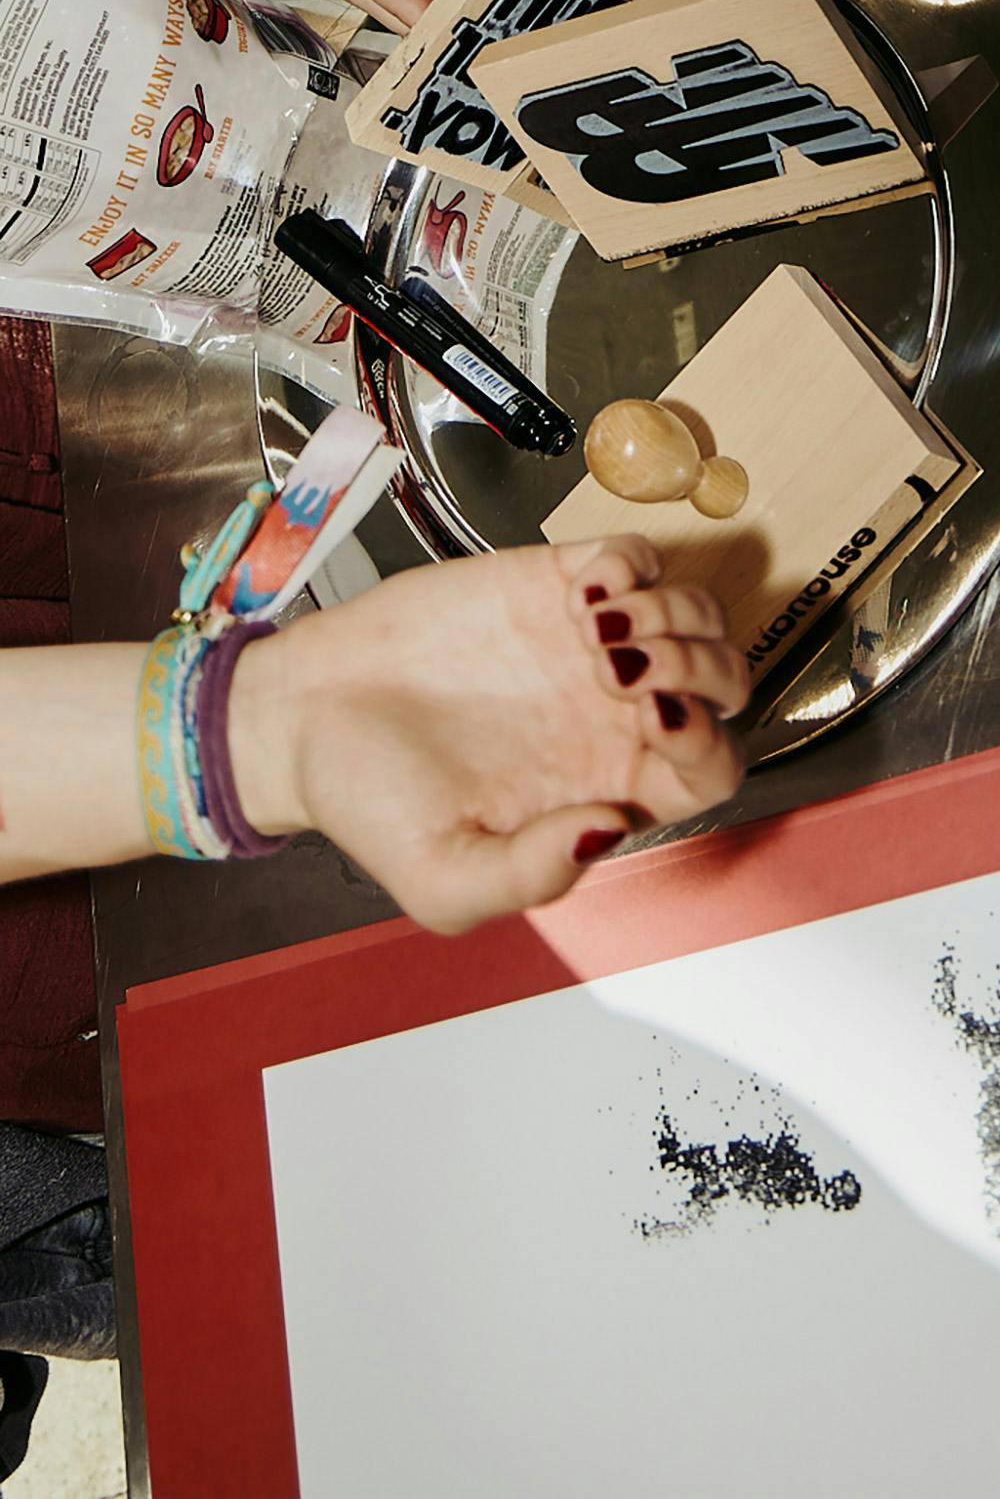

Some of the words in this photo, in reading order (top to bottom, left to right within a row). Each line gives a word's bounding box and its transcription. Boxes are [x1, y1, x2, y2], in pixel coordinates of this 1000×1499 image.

[142, 54, 177, 111] MANY
[131, 112, 156, 140] SO
[125, 144, 149, 169] IN
[116, 169, 139, 192] IT
[79, 195, 127, 247] ENJOY
